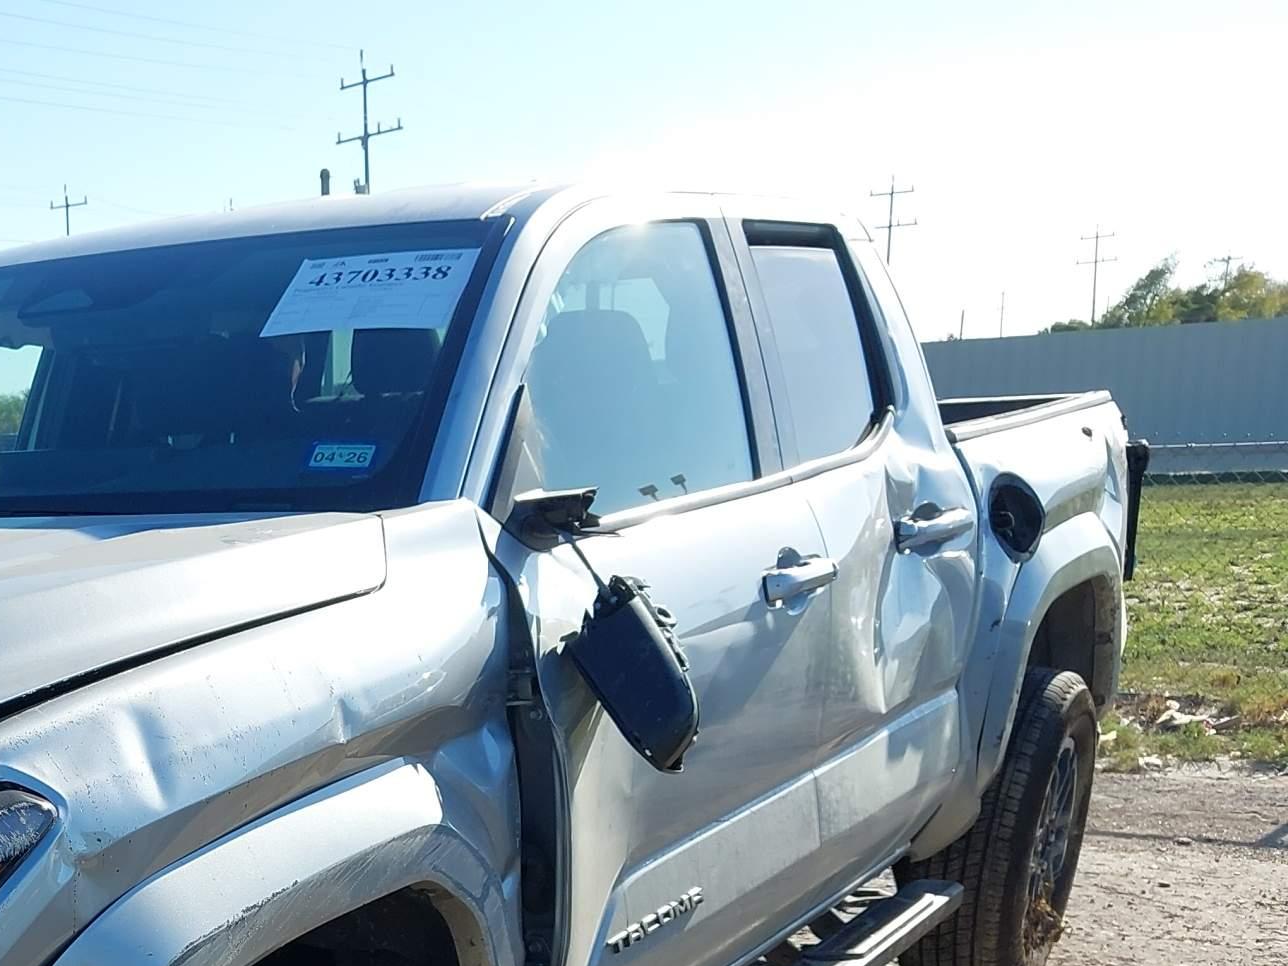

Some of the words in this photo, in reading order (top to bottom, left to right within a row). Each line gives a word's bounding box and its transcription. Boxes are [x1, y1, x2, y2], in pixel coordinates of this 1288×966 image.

[309, 265, 452, 287] 43703338
[314, 452, 336, 463] 04
[344, 452, 369, 463] 26
[604, 886, 703, 953] TACOMA
